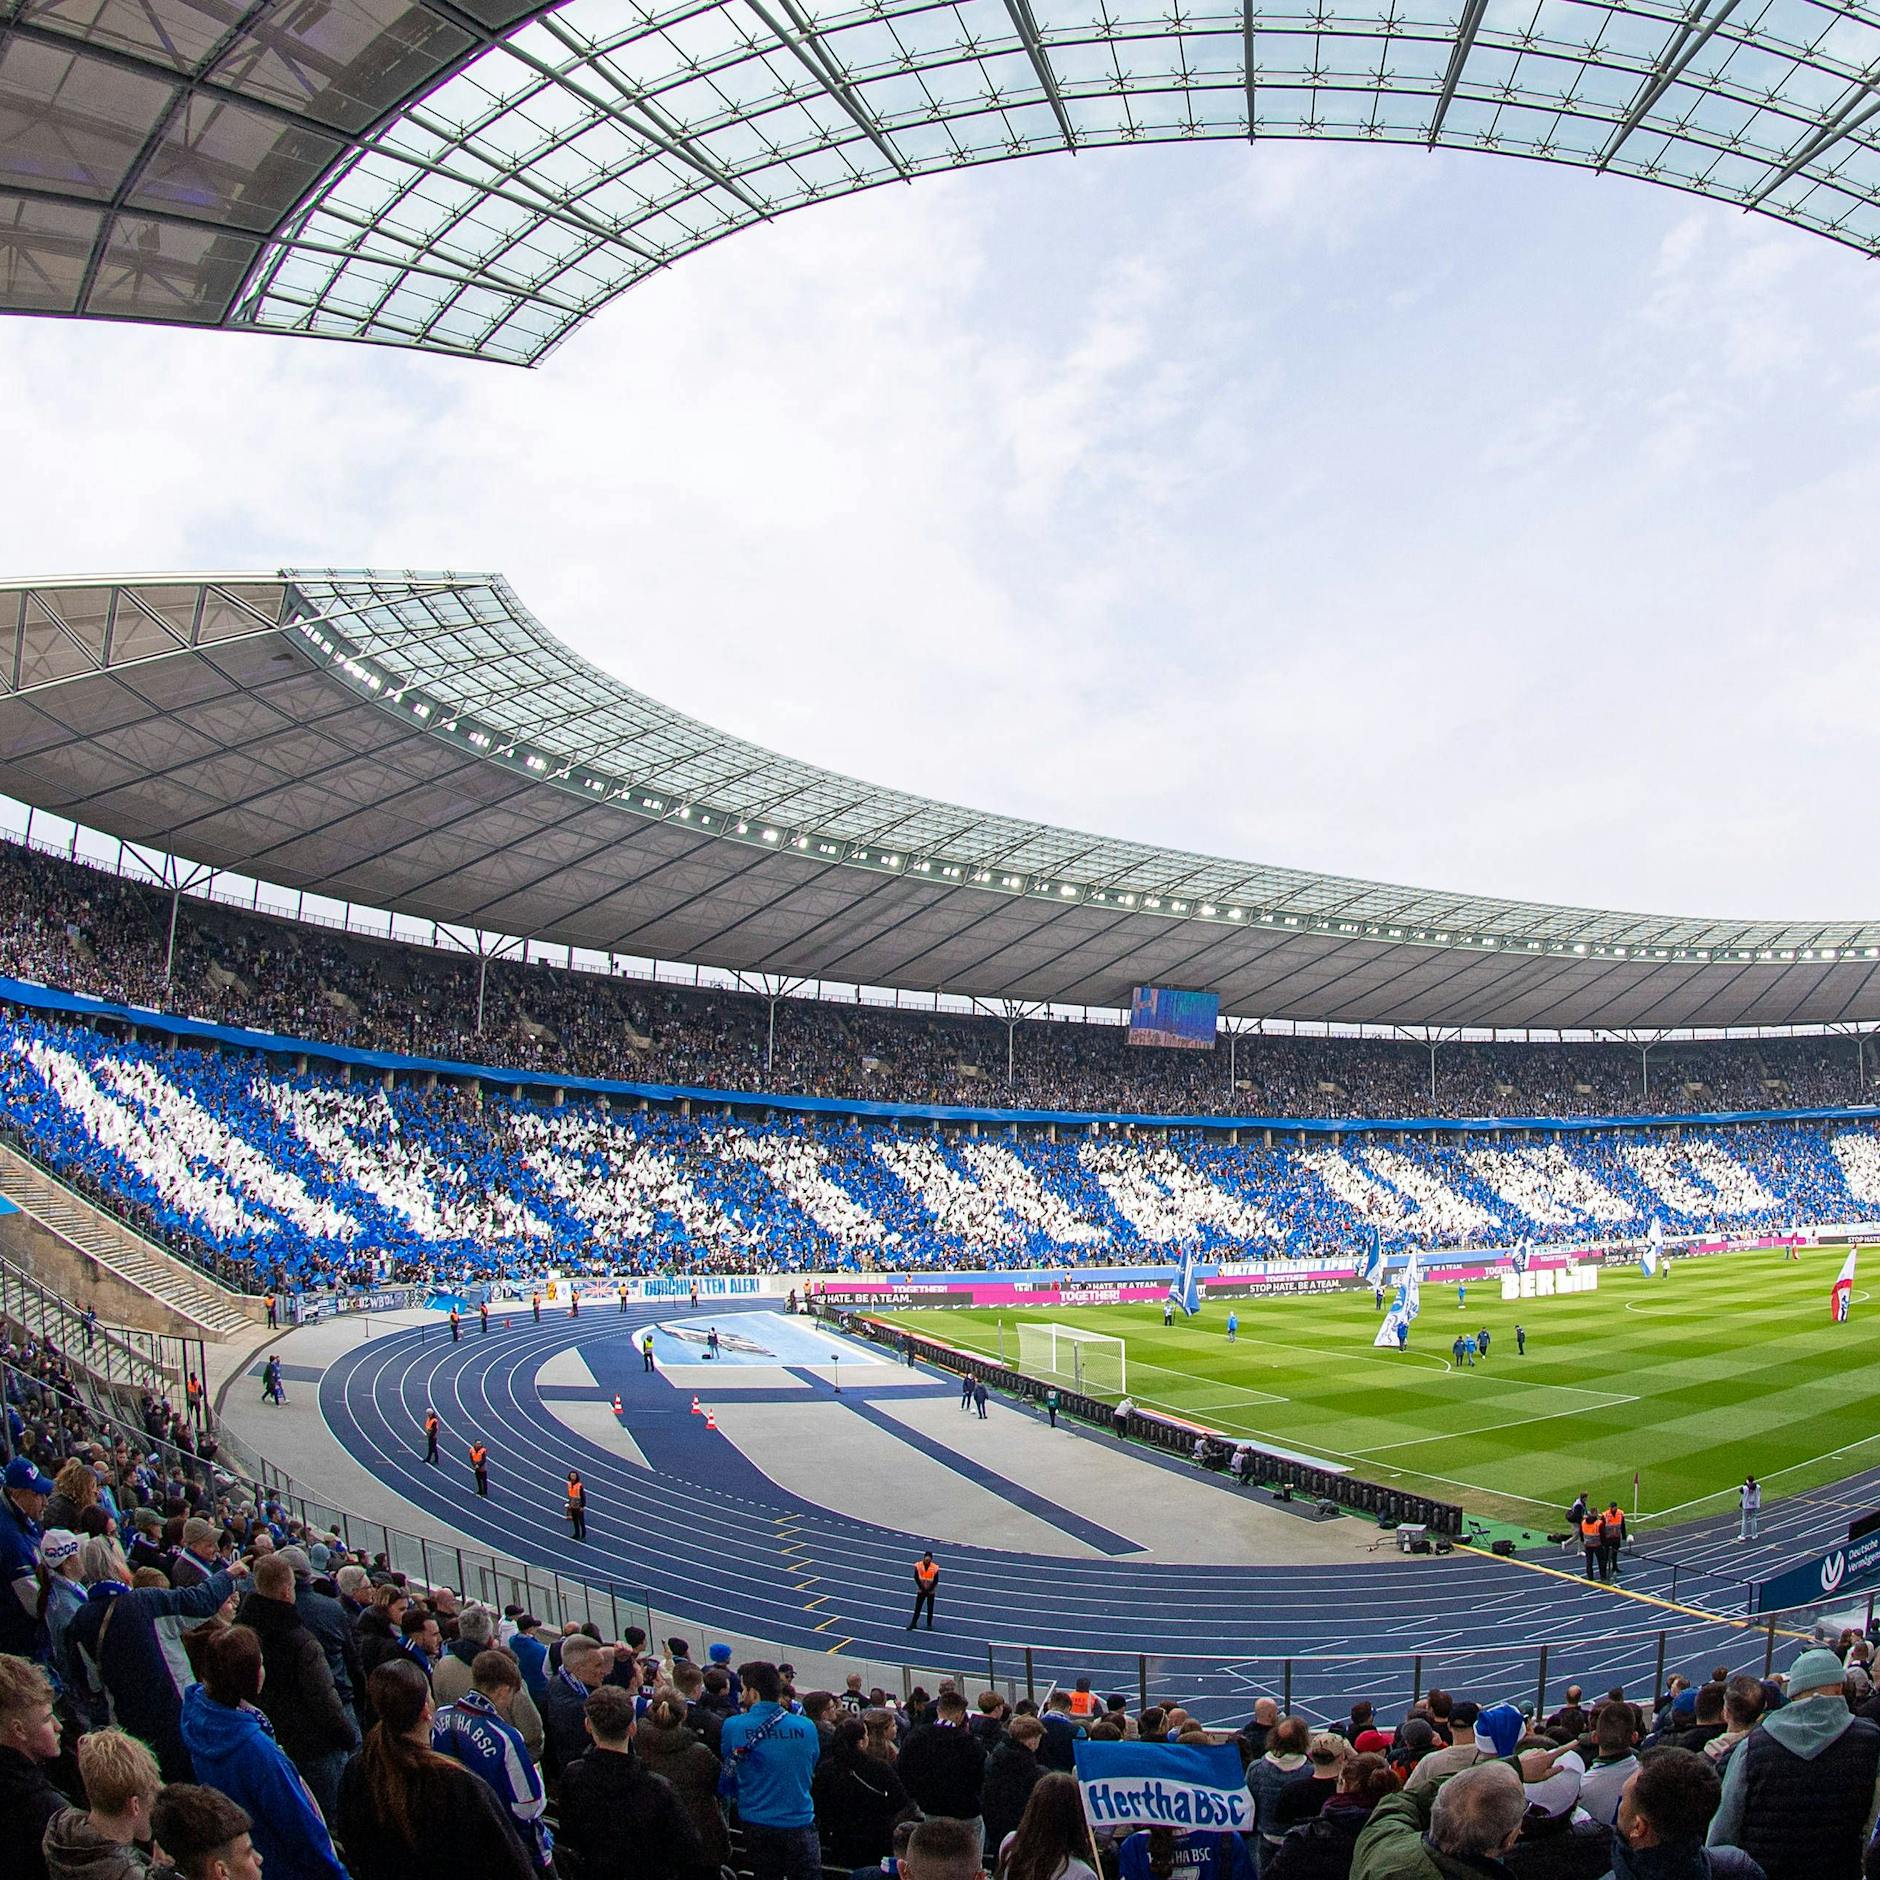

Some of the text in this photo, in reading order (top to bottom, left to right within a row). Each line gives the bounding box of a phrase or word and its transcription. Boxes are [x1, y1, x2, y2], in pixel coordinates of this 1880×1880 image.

[730, 1278, 760, 1294] ALEX!
[1250, 1284, 1271, 1293] STOP
[1273, 1282, 1297, 1292] HATE.
[1298, 1281, 1309, 1290] BE
[1317, 1279, 1342, 1288] TEAM.
[1501, 1265, 1598, 1300] BERLIN
[827, 1293, 853, 1304] HATE.
[855, 1293, 871, 1303] BE
[872, 1293, 879, 1303] A
[880, 1293, 913, 1303] TEAM.
[1059, 1289, 1120, 1302] TOGETHER!
[471, 1727, 497, 1758] BSC
[1191, 1847, 1211, 1861] BSC
